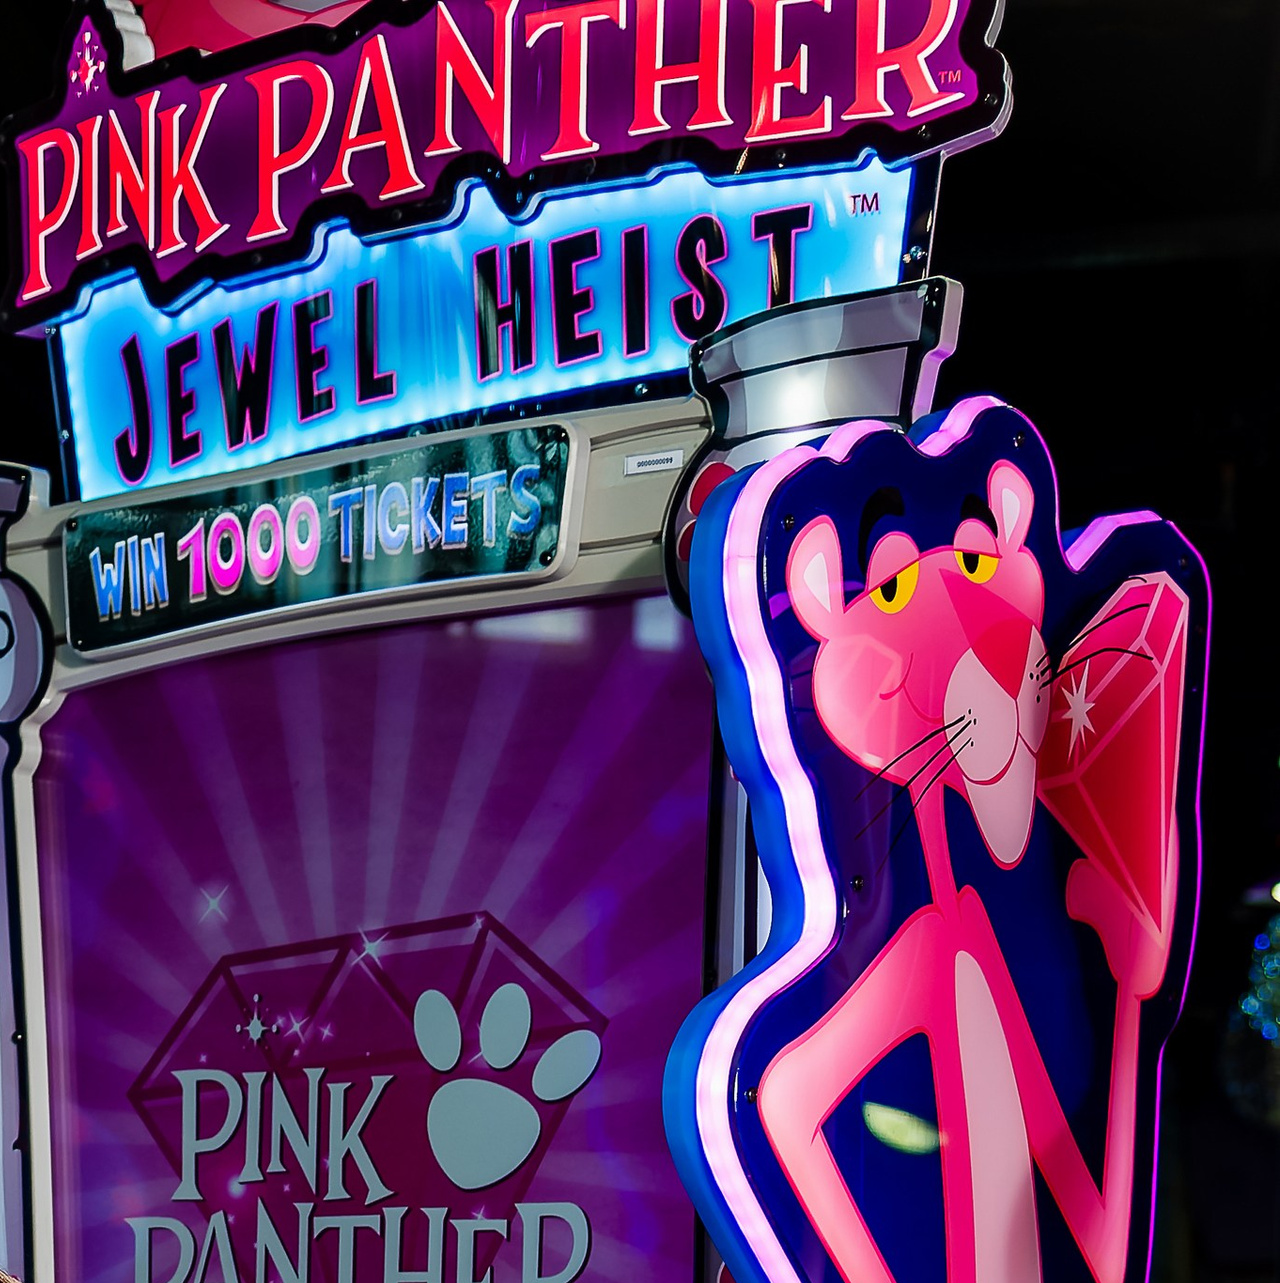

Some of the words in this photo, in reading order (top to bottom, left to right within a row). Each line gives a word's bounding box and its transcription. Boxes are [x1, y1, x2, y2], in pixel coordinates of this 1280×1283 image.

[17, 82, 231, 301] PINK
[244, 0, 966, 242] PANTHER
[113, 278, 398, 487] JEWEL
[472, 202, 814, 384] HEIST
[88, 530, 170, 622] WIN
[176, 494, 321, 603] 1000
[327, 463, 543, 564] TICKETS
[169, 1066, 396, 1206] PINK
